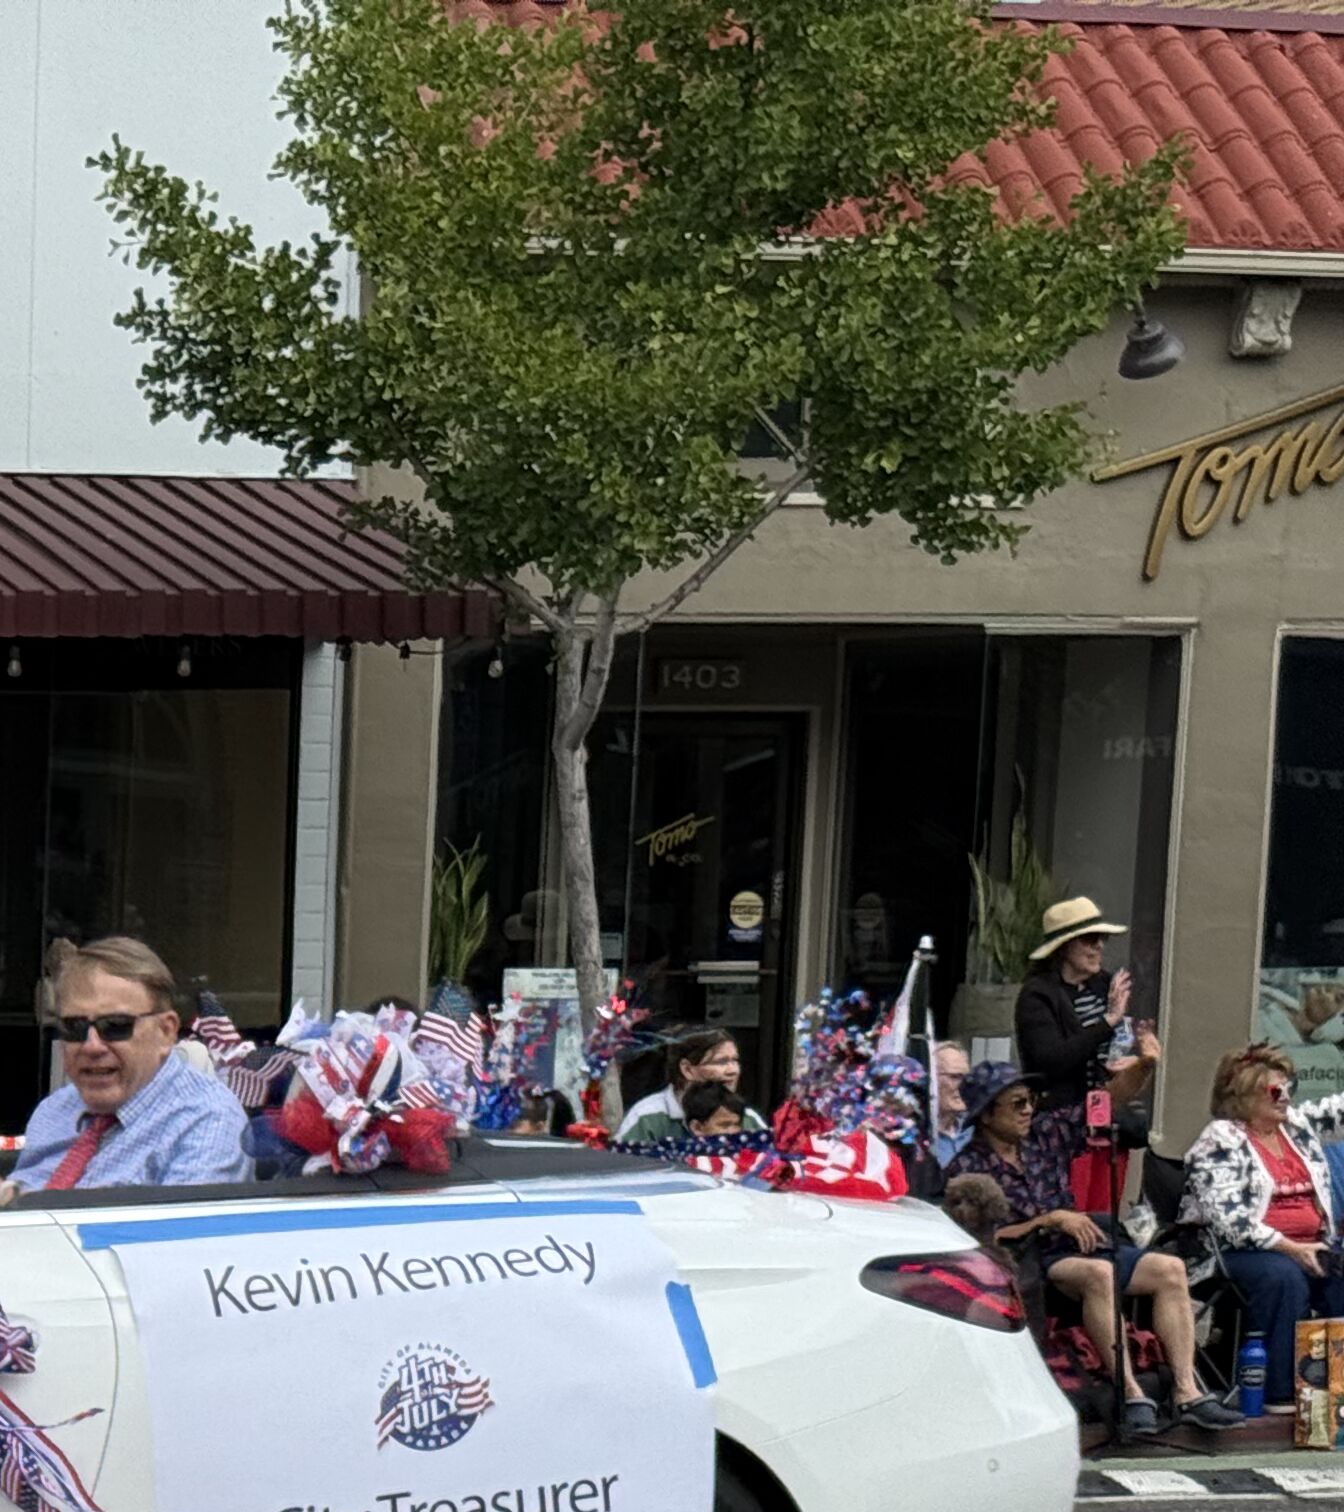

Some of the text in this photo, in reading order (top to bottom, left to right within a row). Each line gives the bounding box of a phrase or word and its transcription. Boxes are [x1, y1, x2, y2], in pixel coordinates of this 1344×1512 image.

[662, 664, 742, 690] 1403
[633, 811, 716, 868] Tomo
[204, 1233, 598, 1318] Kevin Kennedy
[398, 1353, 452, 1405] 4TH
[393, 1386, 461, 1435] JULY
